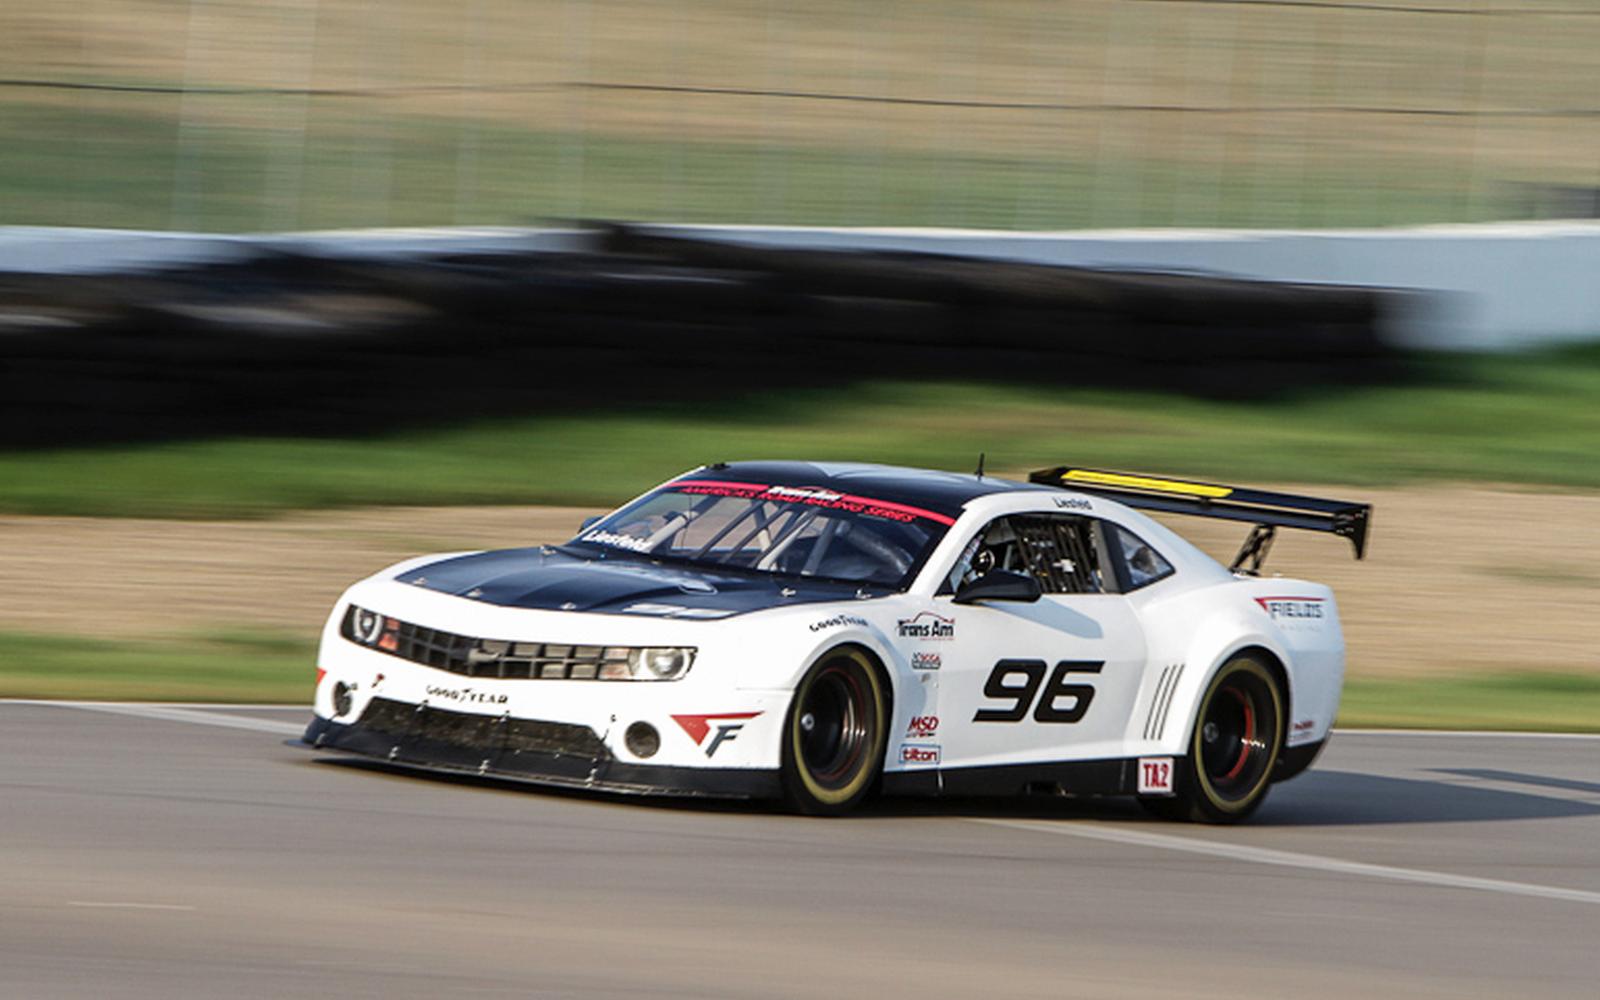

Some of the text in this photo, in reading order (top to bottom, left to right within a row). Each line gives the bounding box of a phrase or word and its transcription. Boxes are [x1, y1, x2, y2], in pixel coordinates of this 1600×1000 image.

[864, 505, 915, 522] SERIES
[897, 619, 954, 637] Trans Am
[972, 658, 1106, 724] 96
[907, 716, 939, 731] MSD
[903, 748, 937, 761] tilton
[1143, 763, 1169, 787] TA2
